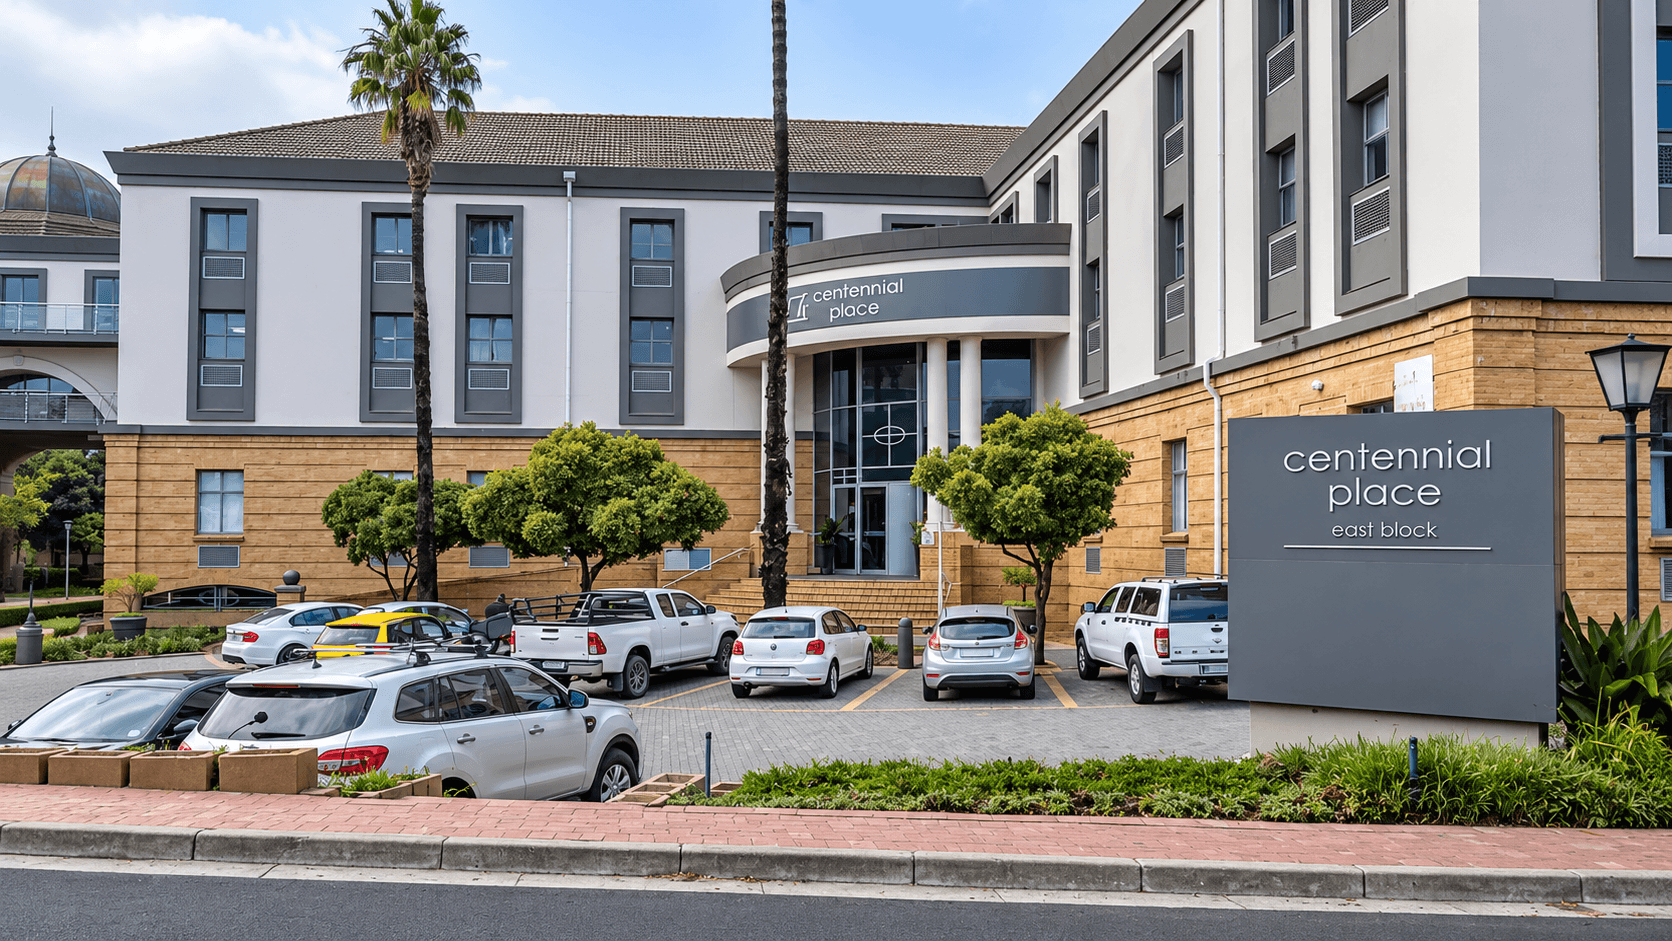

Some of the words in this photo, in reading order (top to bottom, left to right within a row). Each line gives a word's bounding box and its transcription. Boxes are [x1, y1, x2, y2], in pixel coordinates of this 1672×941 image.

[813, 277, 903, 303] centennial
[829, 302, 880, 323] place
[1283, 439, 1492, 472] centennial
[1329, 476, 1442, 512] place
[1331, 521, 1374, 538] east
[1380, 521, 1438, 538] block
